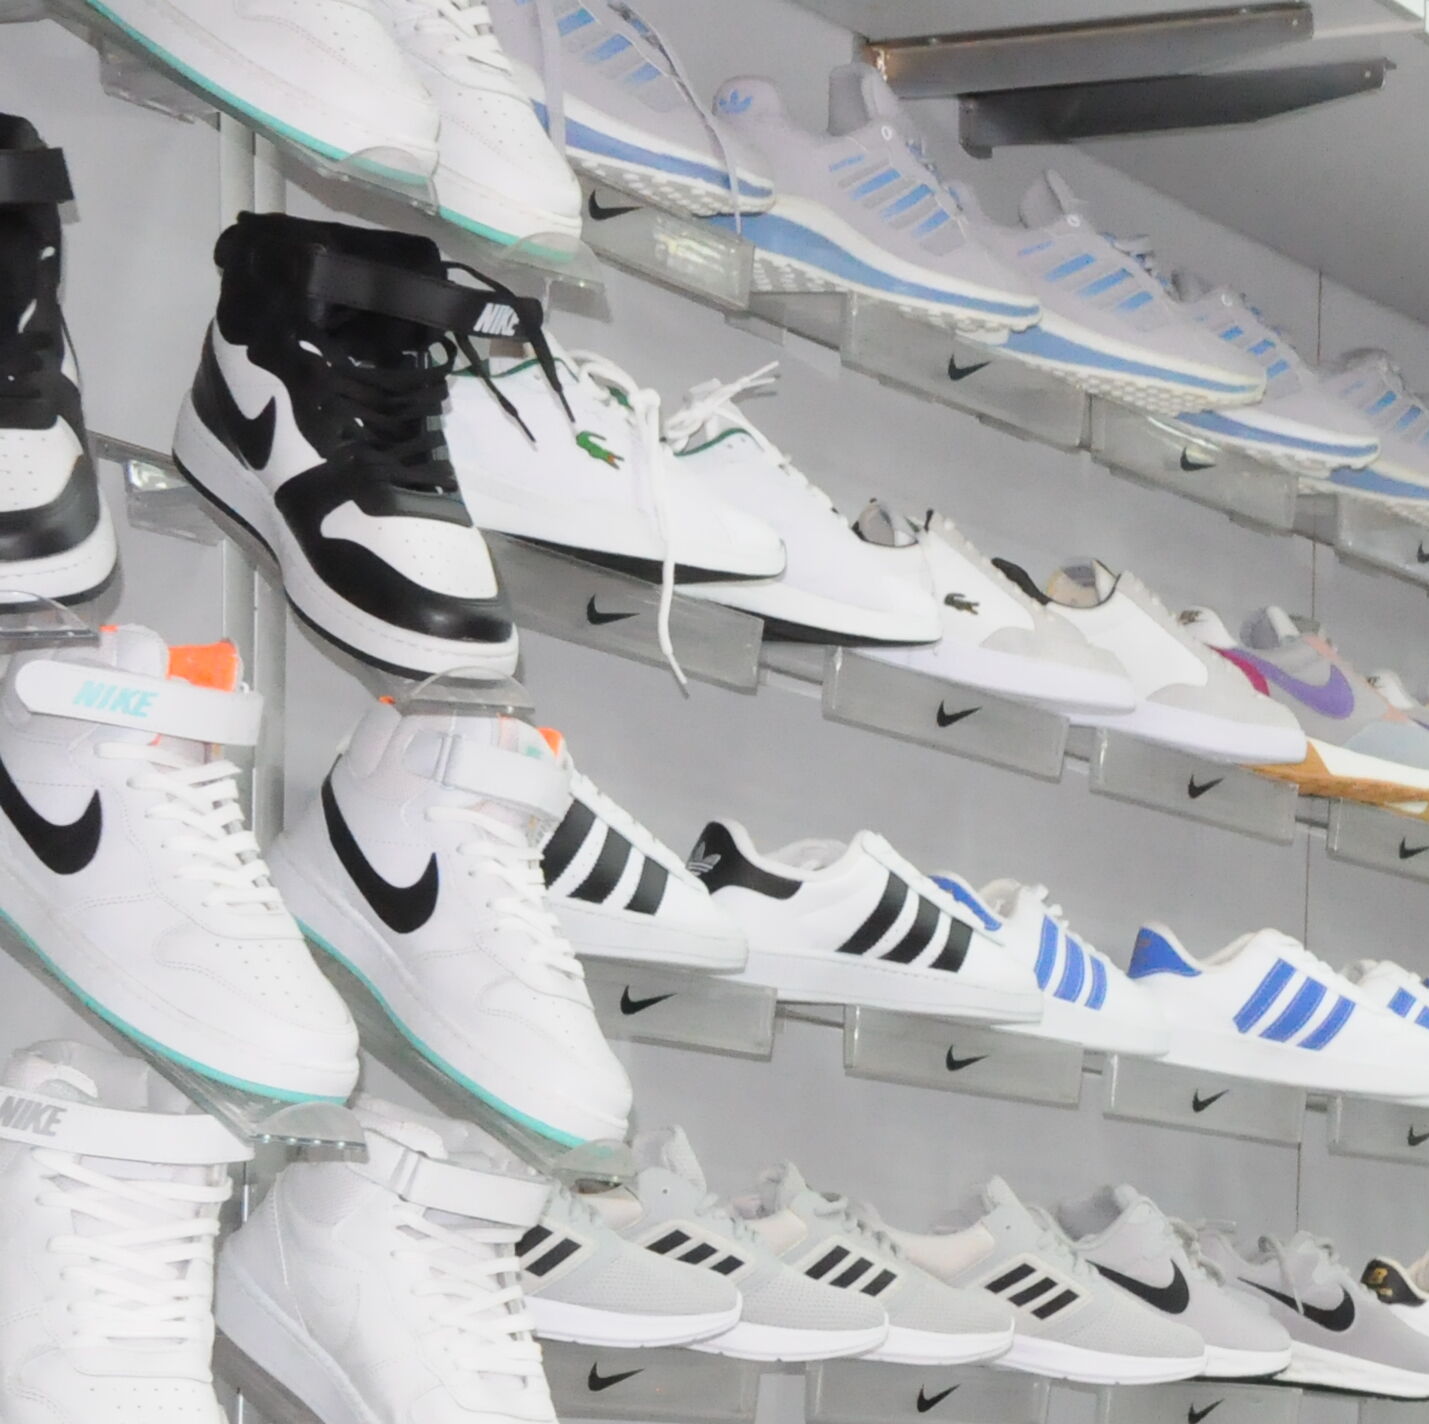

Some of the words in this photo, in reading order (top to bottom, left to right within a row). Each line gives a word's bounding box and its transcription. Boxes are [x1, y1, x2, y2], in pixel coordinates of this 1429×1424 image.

[473, 302, 520, 337] NIKE
[72, 679, 161, 719] NIKE
[0, 1095, 68, 1137] NIKE
